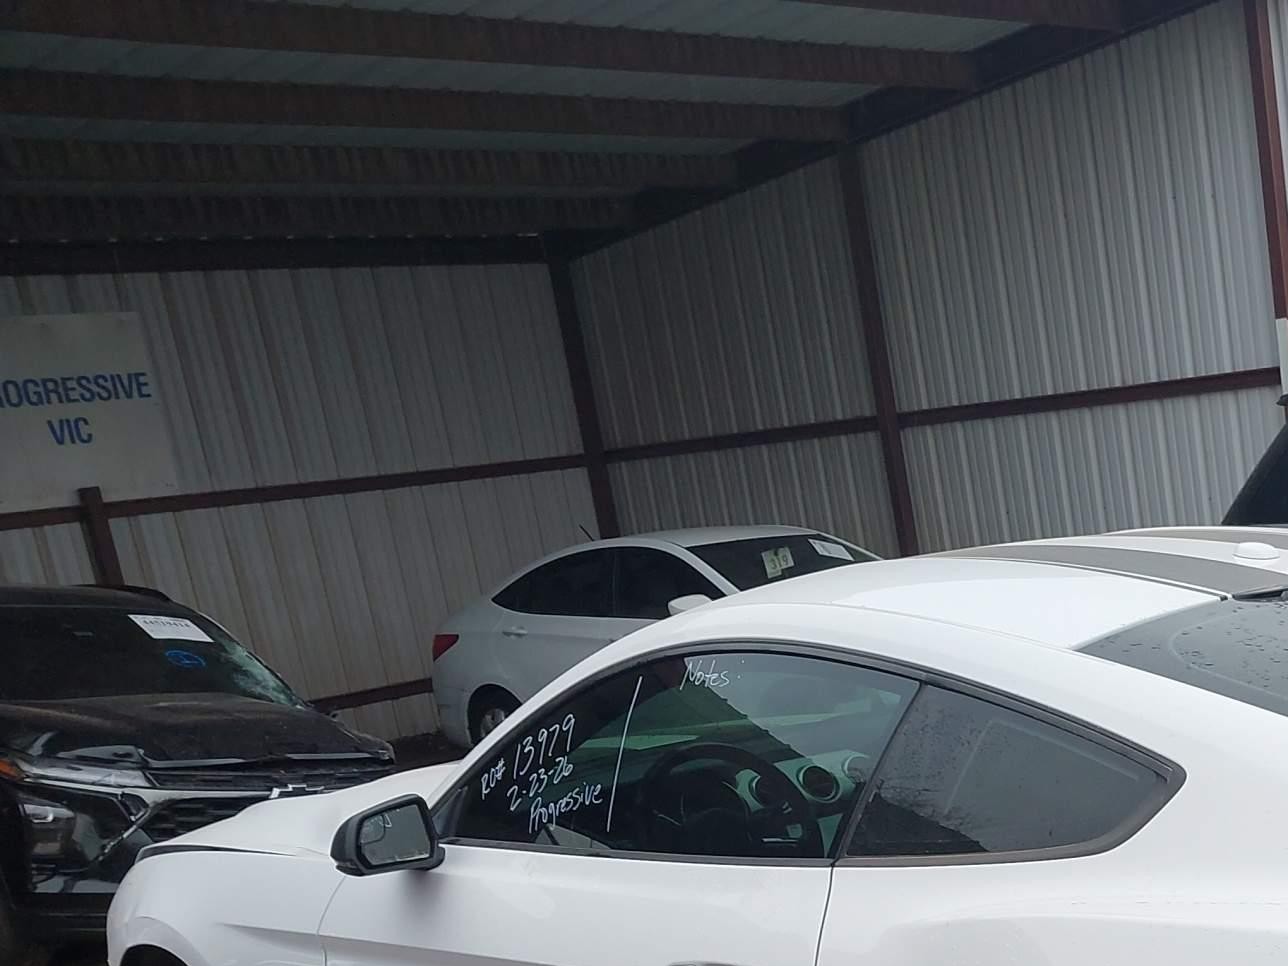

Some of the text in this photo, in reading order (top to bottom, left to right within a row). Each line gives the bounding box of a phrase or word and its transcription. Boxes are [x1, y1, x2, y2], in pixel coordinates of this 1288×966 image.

[0, 372, 152, 408] OGRESSIVE
[47, 416, 93, 445] VIC
[513, 714, 575, 780] 13979
[506, 755, 574, 812] 2-23-26
[528, 781, 603, 834] Progressive
